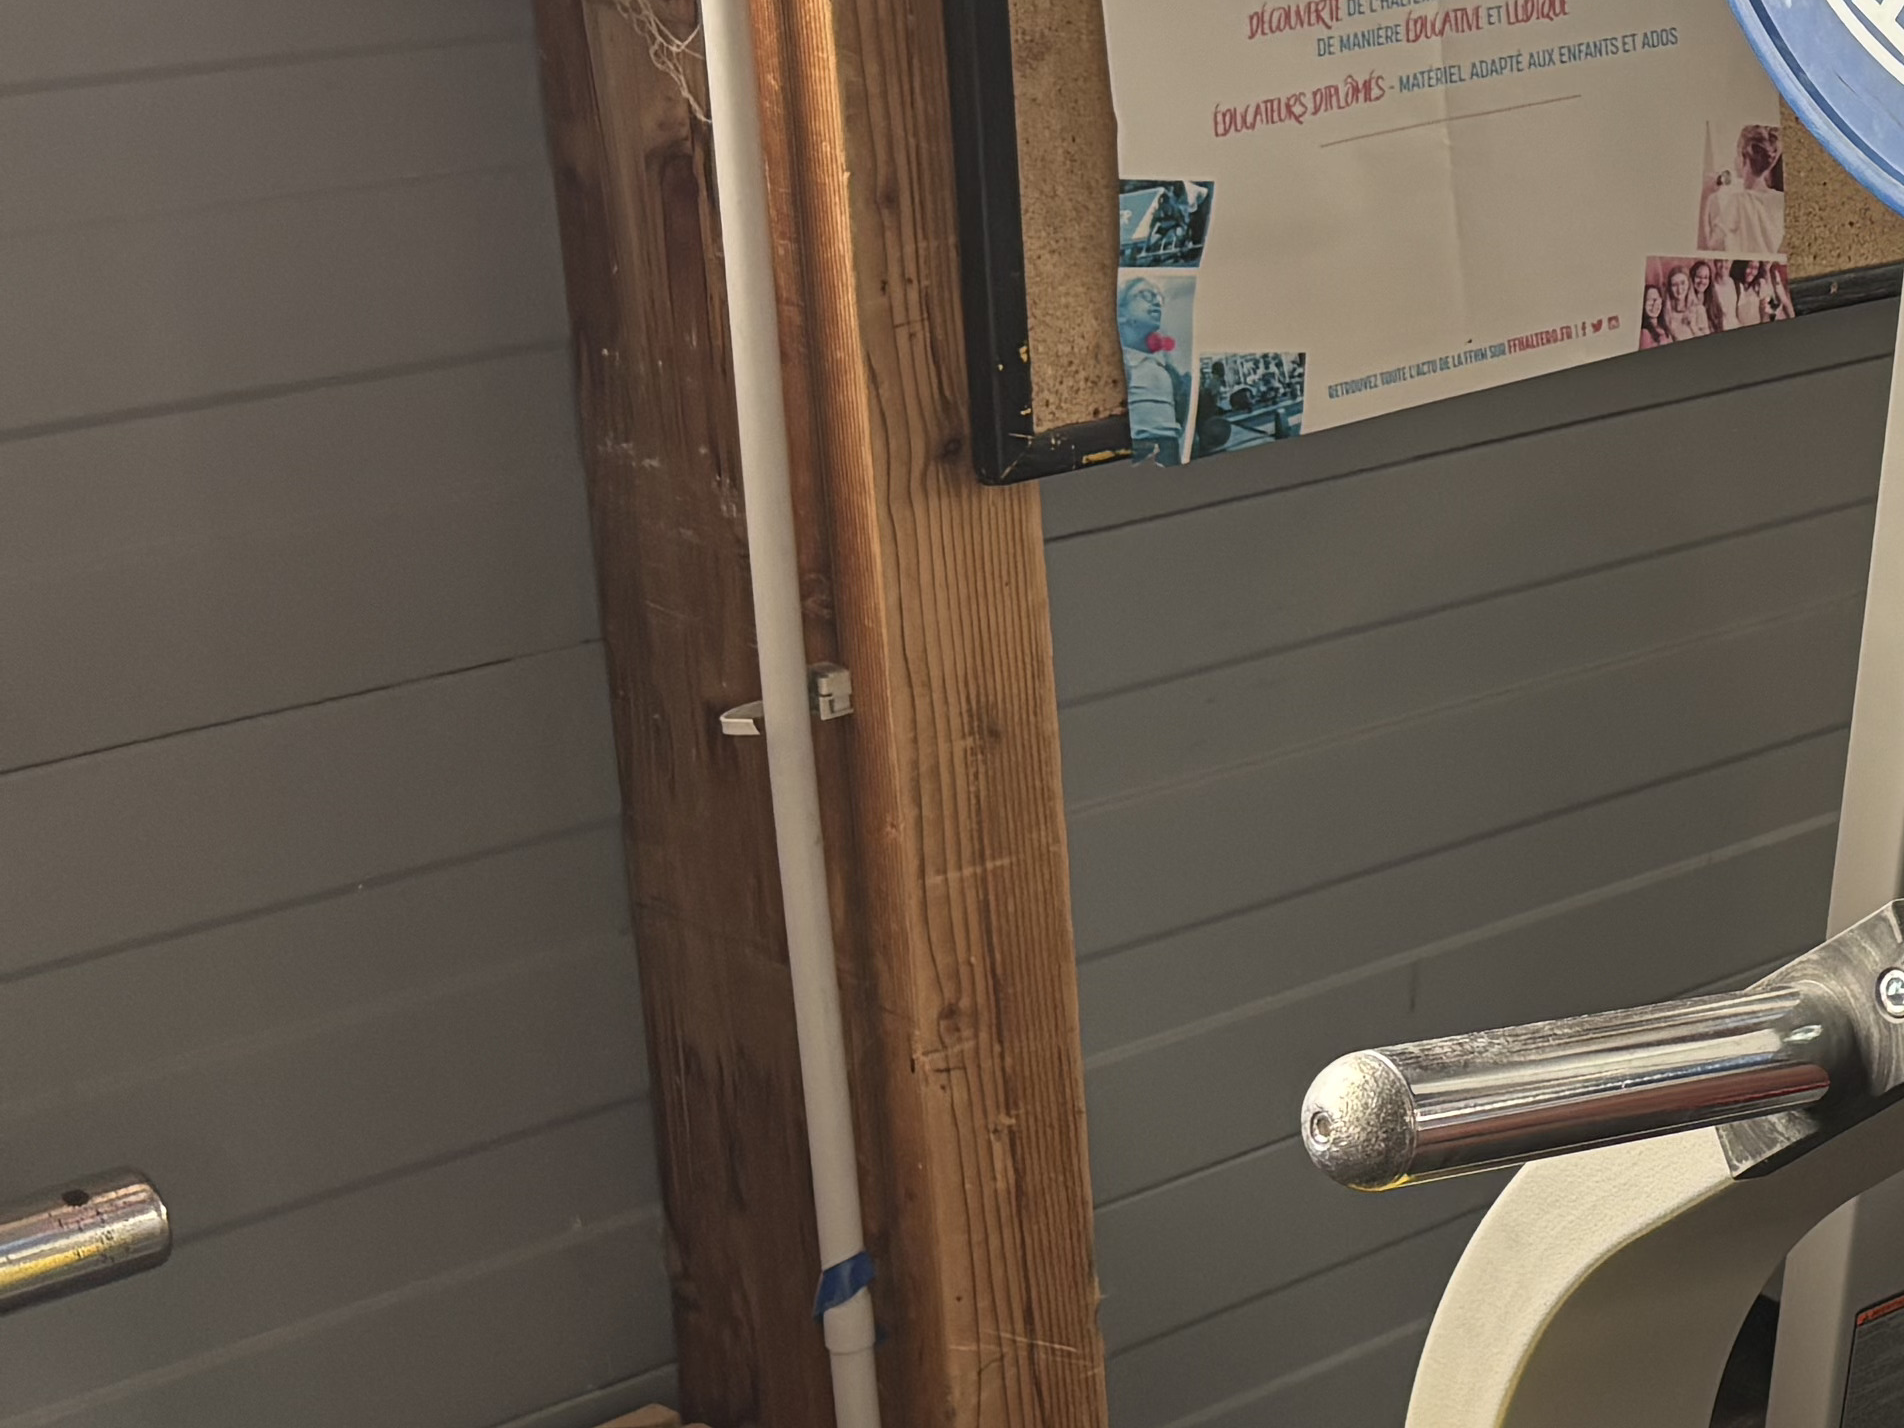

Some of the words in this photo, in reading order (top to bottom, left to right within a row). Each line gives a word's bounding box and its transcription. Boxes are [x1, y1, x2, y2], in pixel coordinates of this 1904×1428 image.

[1316, 37, 1336, 57] DE
[1339, 21, 1403, 53] MANIÈRE
[1404, 4, 1484, 44] ÉDUCATIVE
[1486, 5, 1503, 26] ET
[1213, 91, 1308, 138] ÉDUCATEURS
[1310, 70, 1387, 117] DIPLÔMÉS
[1398, 59, 1467, 94] MATÉRIEL
[1469, 47, 1525, 79] ADAPTÉ
[1527, 48, 1557, 70] AUX
[1558, 37, 1620, 64] ENFANTS
[1622, 33, 1638, 53] ET
[1640, 27, 1679, 50] ADOS
[1328, 376, 1379, 400] RETROUVEZ
[1379, 367, 1407, 387] TOUTE
[1438, 356, 1451, 372] DE
[1451, 353, 1464, 368] LA
[1489, 342, 1507, 360] SUR
